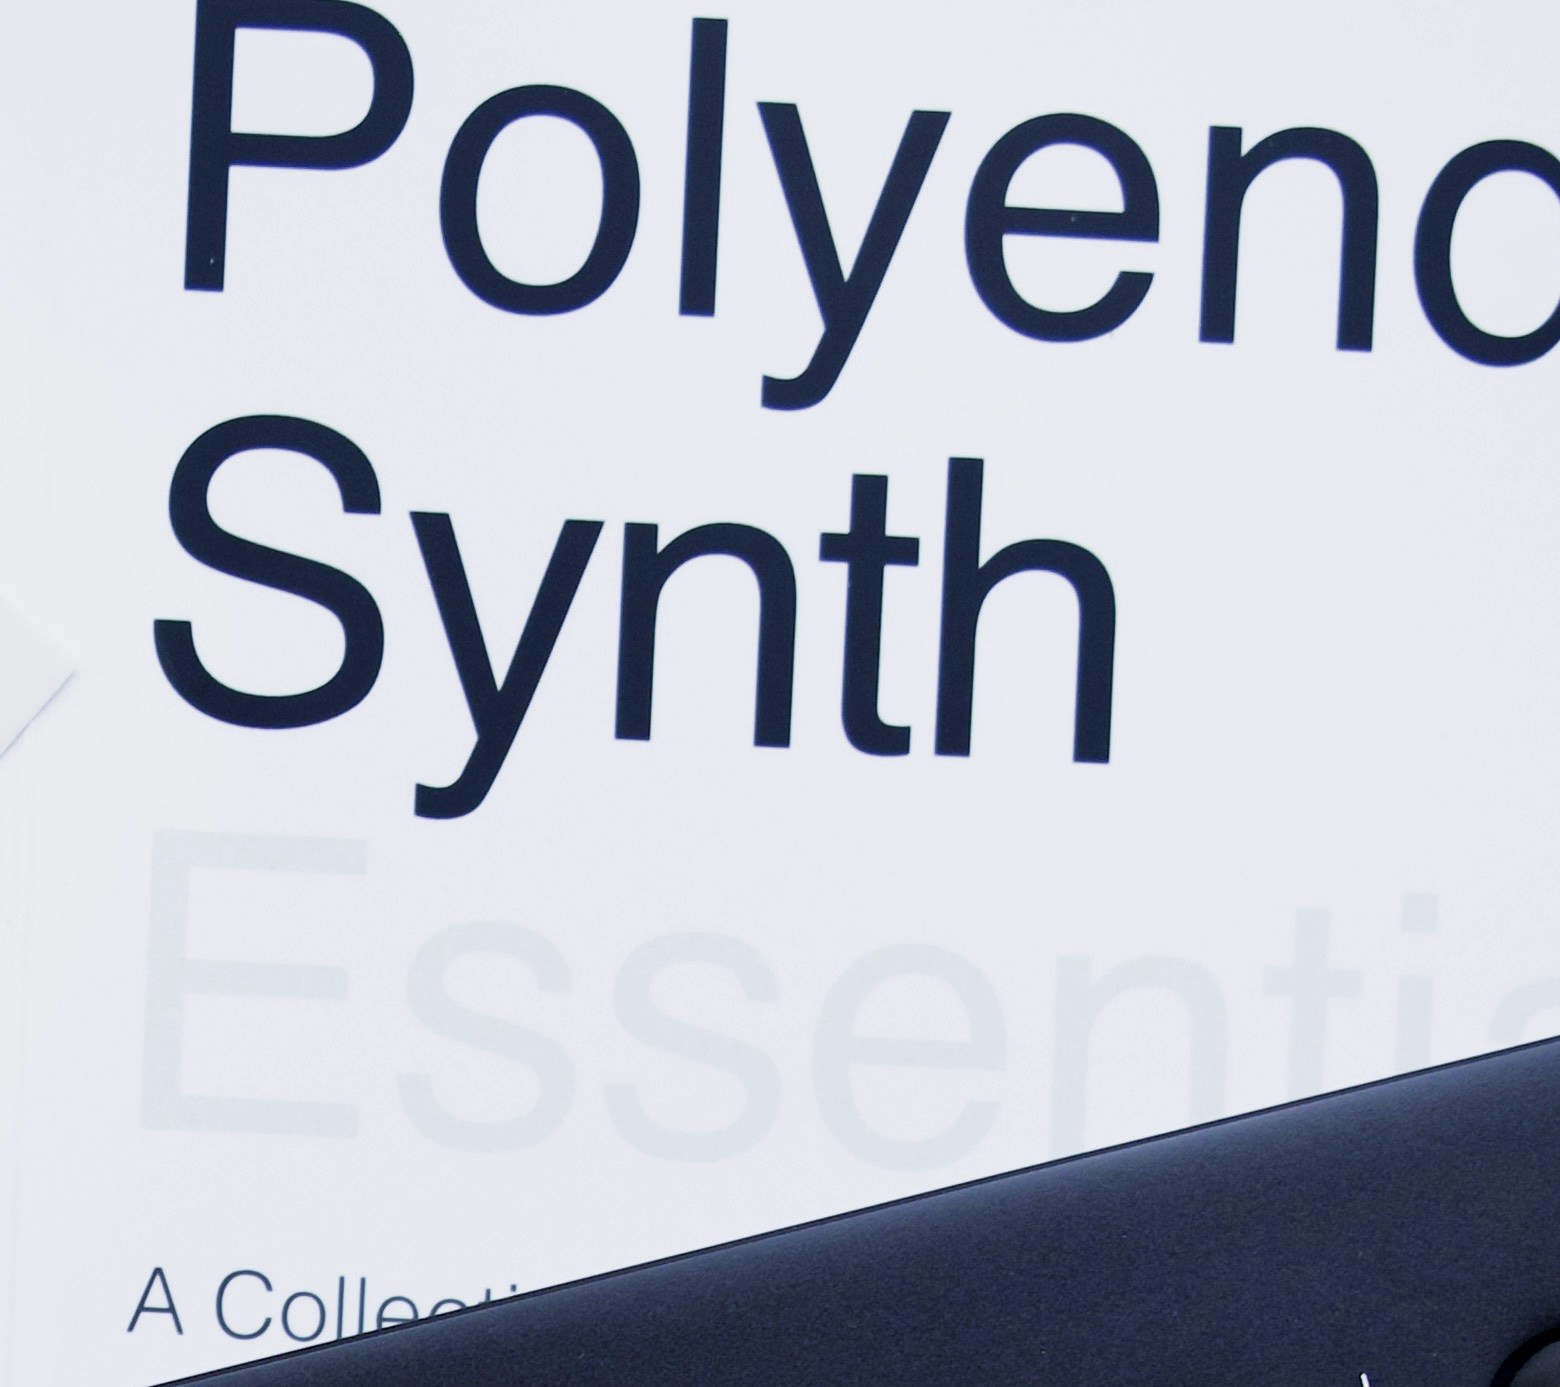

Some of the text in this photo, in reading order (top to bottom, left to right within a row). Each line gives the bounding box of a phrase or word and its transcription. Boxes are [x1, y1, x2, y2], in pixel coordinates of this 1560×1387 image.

[152, 413, 1117, 821] Synth
[126, 1266, 518, 1342] A Colle
